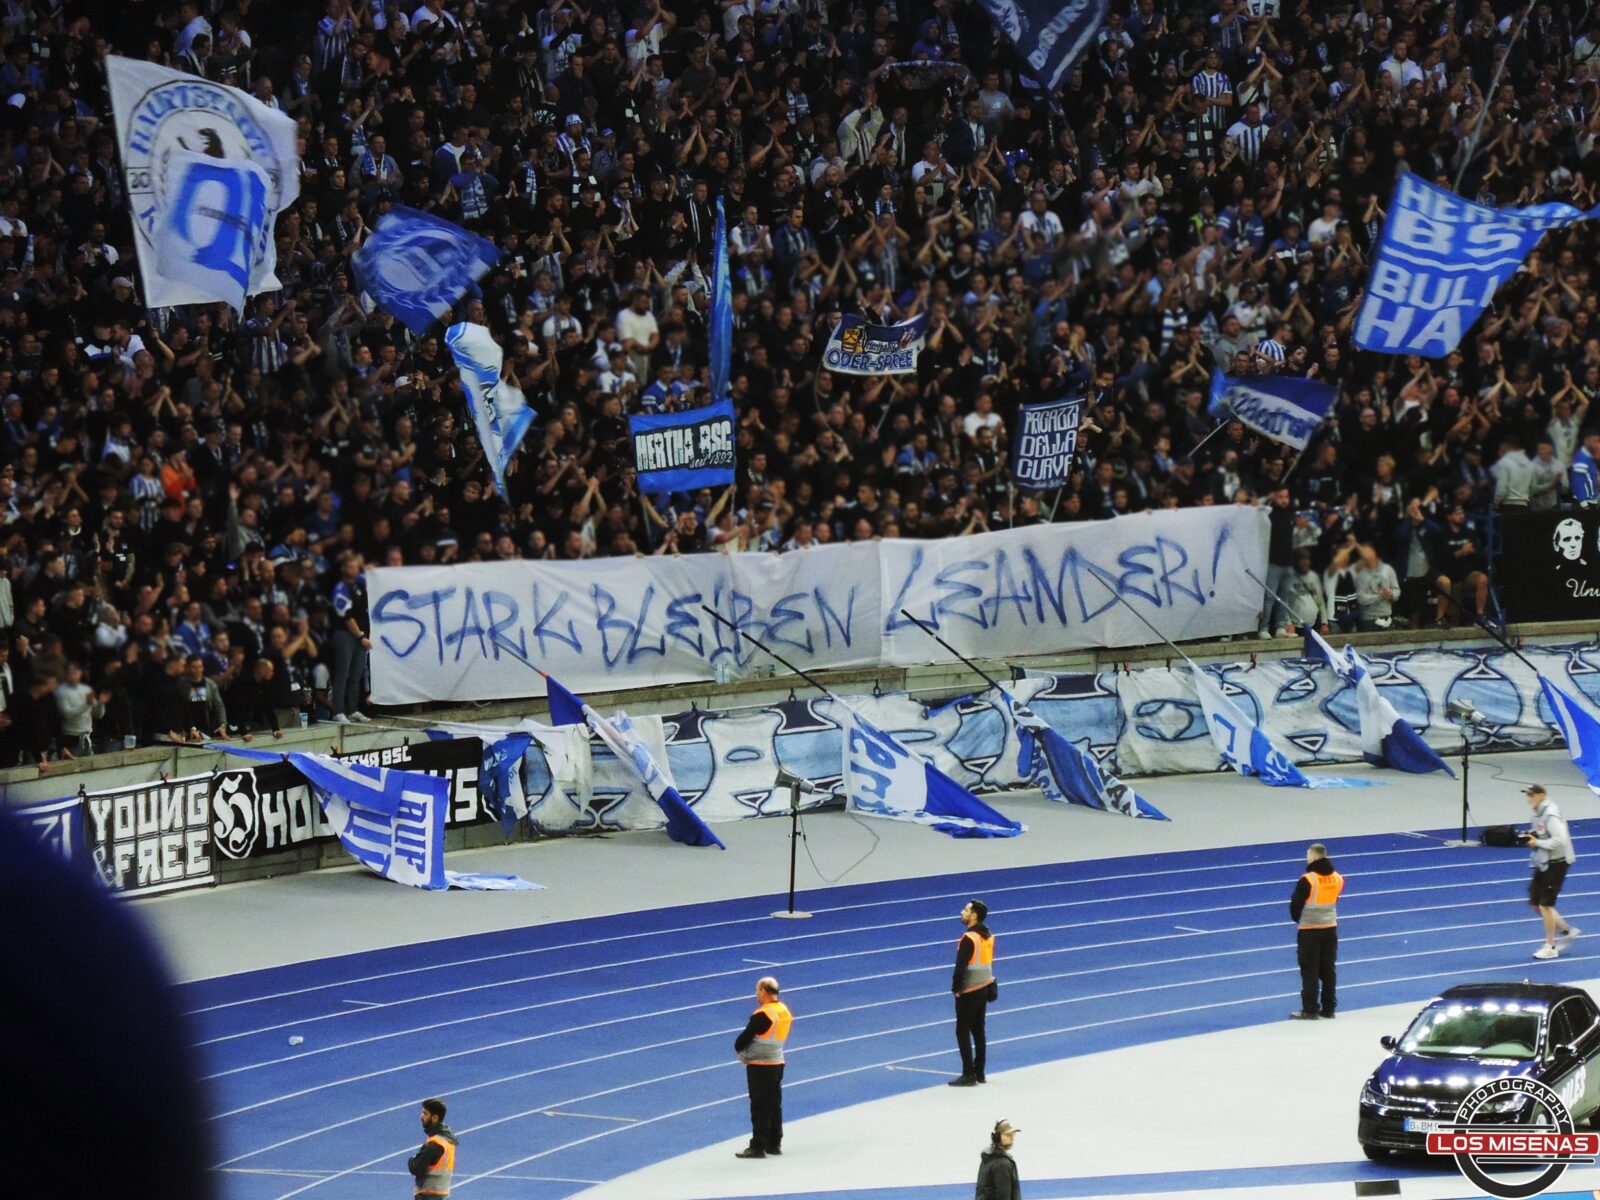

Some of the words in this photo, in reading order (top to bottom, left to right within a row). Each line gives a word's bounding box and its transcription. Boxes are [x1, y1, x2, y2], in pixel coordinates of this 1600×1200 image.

[827, 348, 914, 371] ODER-SPREE
[635, 428, 695, 472] HERTHA
[699, 420, 732, 459] BSC
[709, 451, 733, 465] 1892
[1020, 430, 1077, 458] DELLA
[371, 582, 583, 667] STARK
[589, 576, 860, 668] BLEIBEN
[884, 520, 1232, 634] LEANDER!
[382, 746, 412, 765] BSC
[88, 781, 210, 842] YOUNG
[113, 828, 211, 890] FREE
